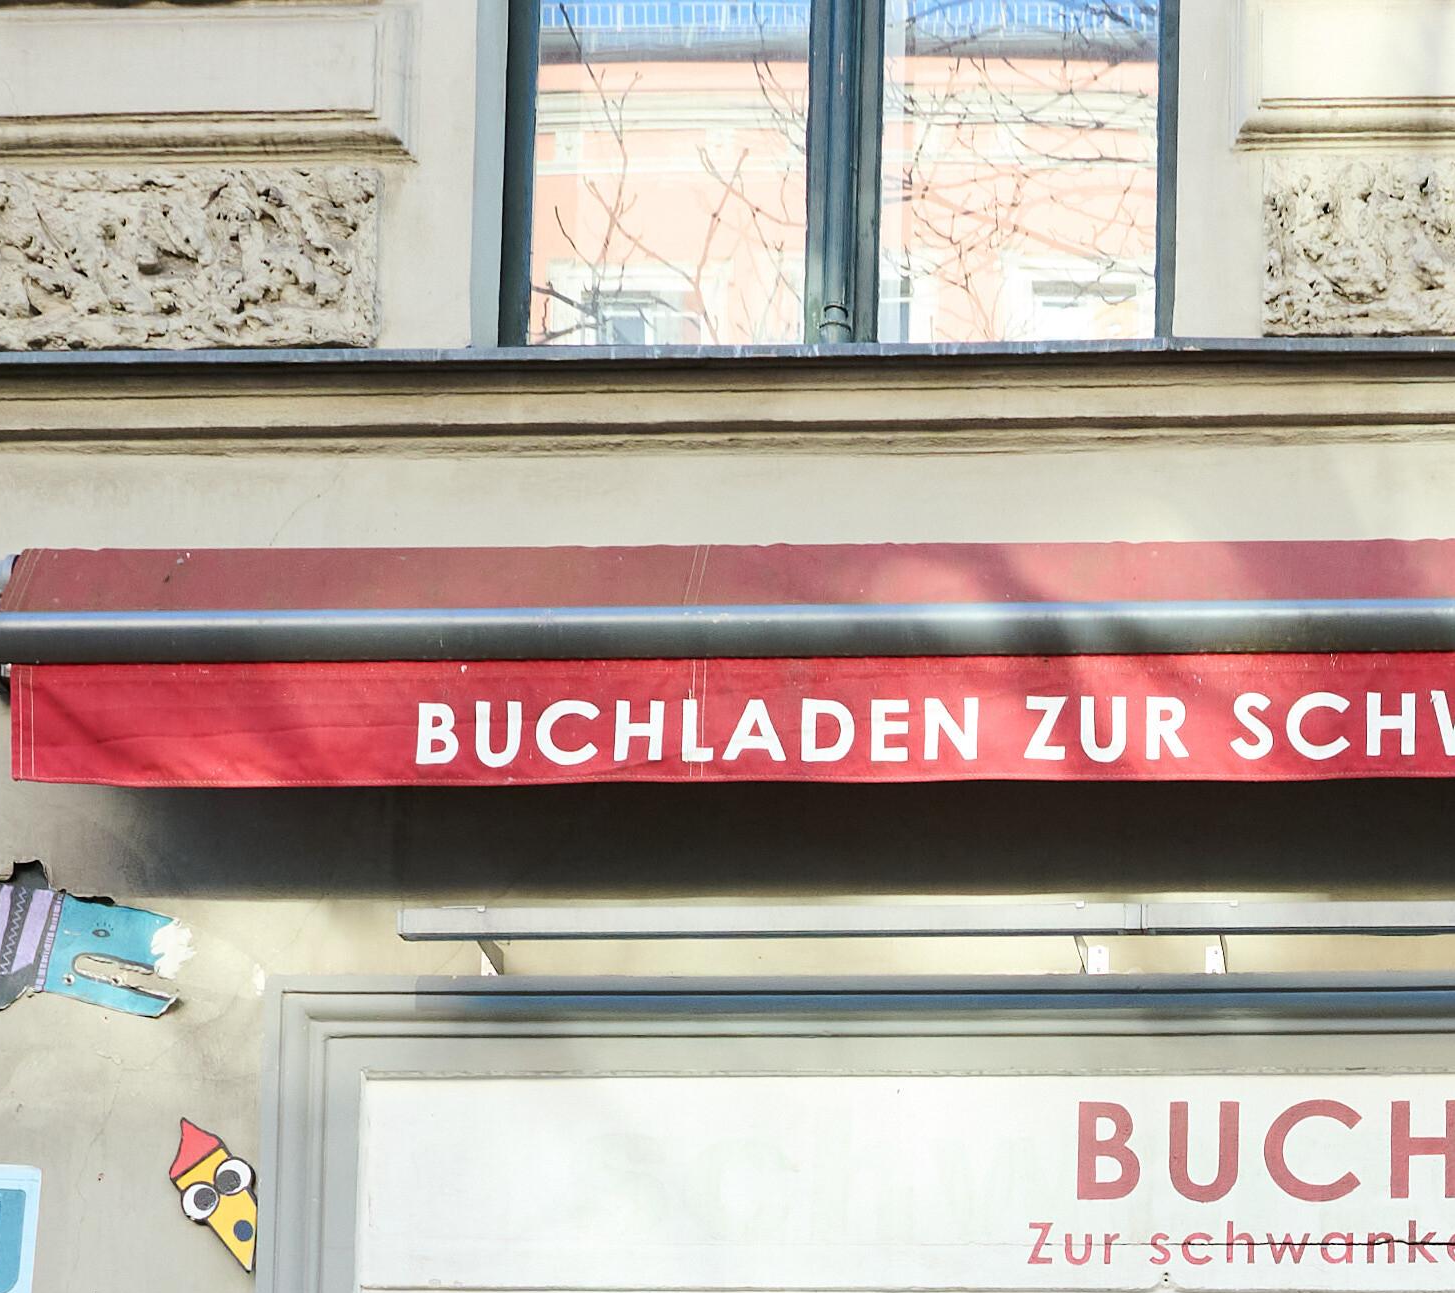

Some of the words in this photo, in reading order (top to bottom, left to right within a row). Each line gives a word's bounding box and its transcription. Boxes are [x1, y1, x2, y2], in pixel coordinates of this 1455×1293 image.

[413, 694, 983, 768] BUCHLADEN
[1024, 690, 1188, 764] ZUR
[1026, 1221, 1124, 1267] Zur
